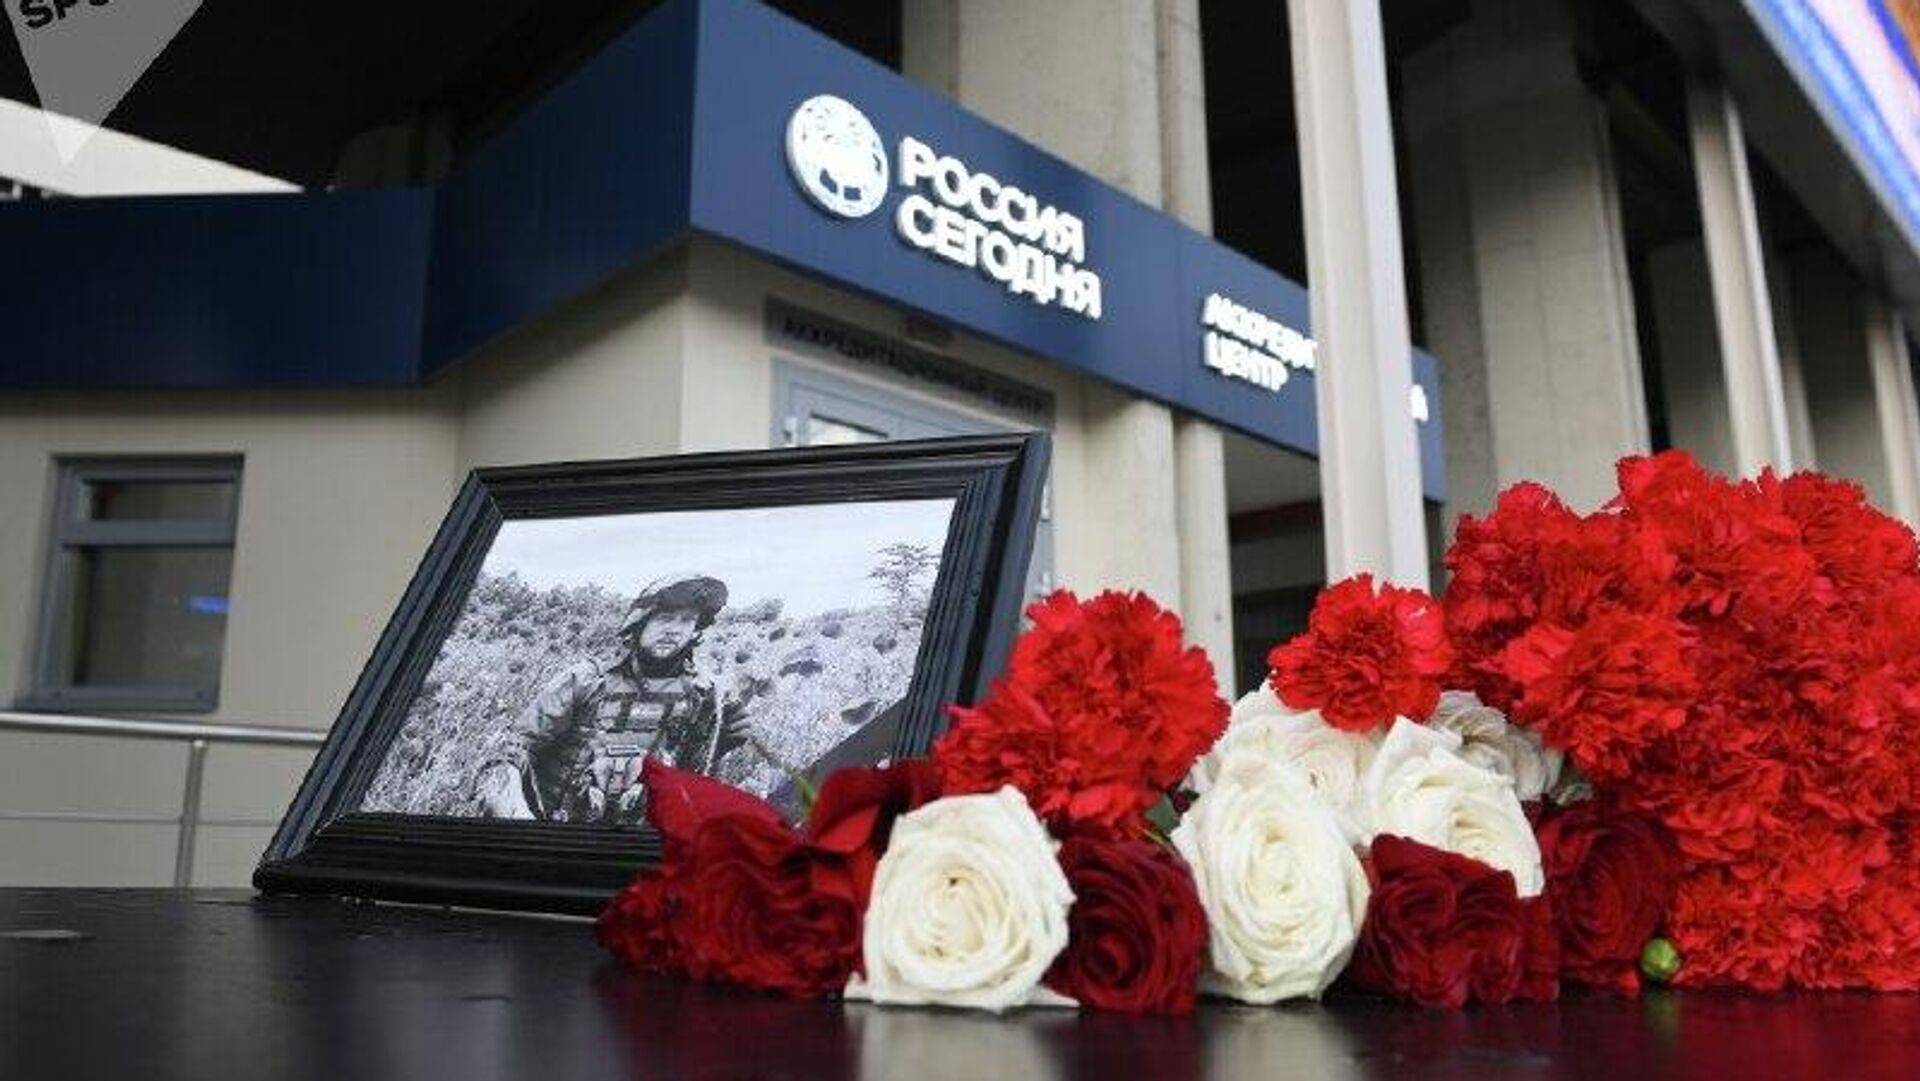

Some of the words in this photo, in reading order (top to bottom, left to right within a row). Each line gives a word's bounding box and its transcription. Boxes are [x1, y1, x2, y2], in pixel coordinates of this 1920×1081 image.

[897, 194, 1102, 319] СЕГОДНЯ
[900, 136, 1085, 263] РОССИЯ
[1204, 331, 1288, 392] ЦЕНТР
